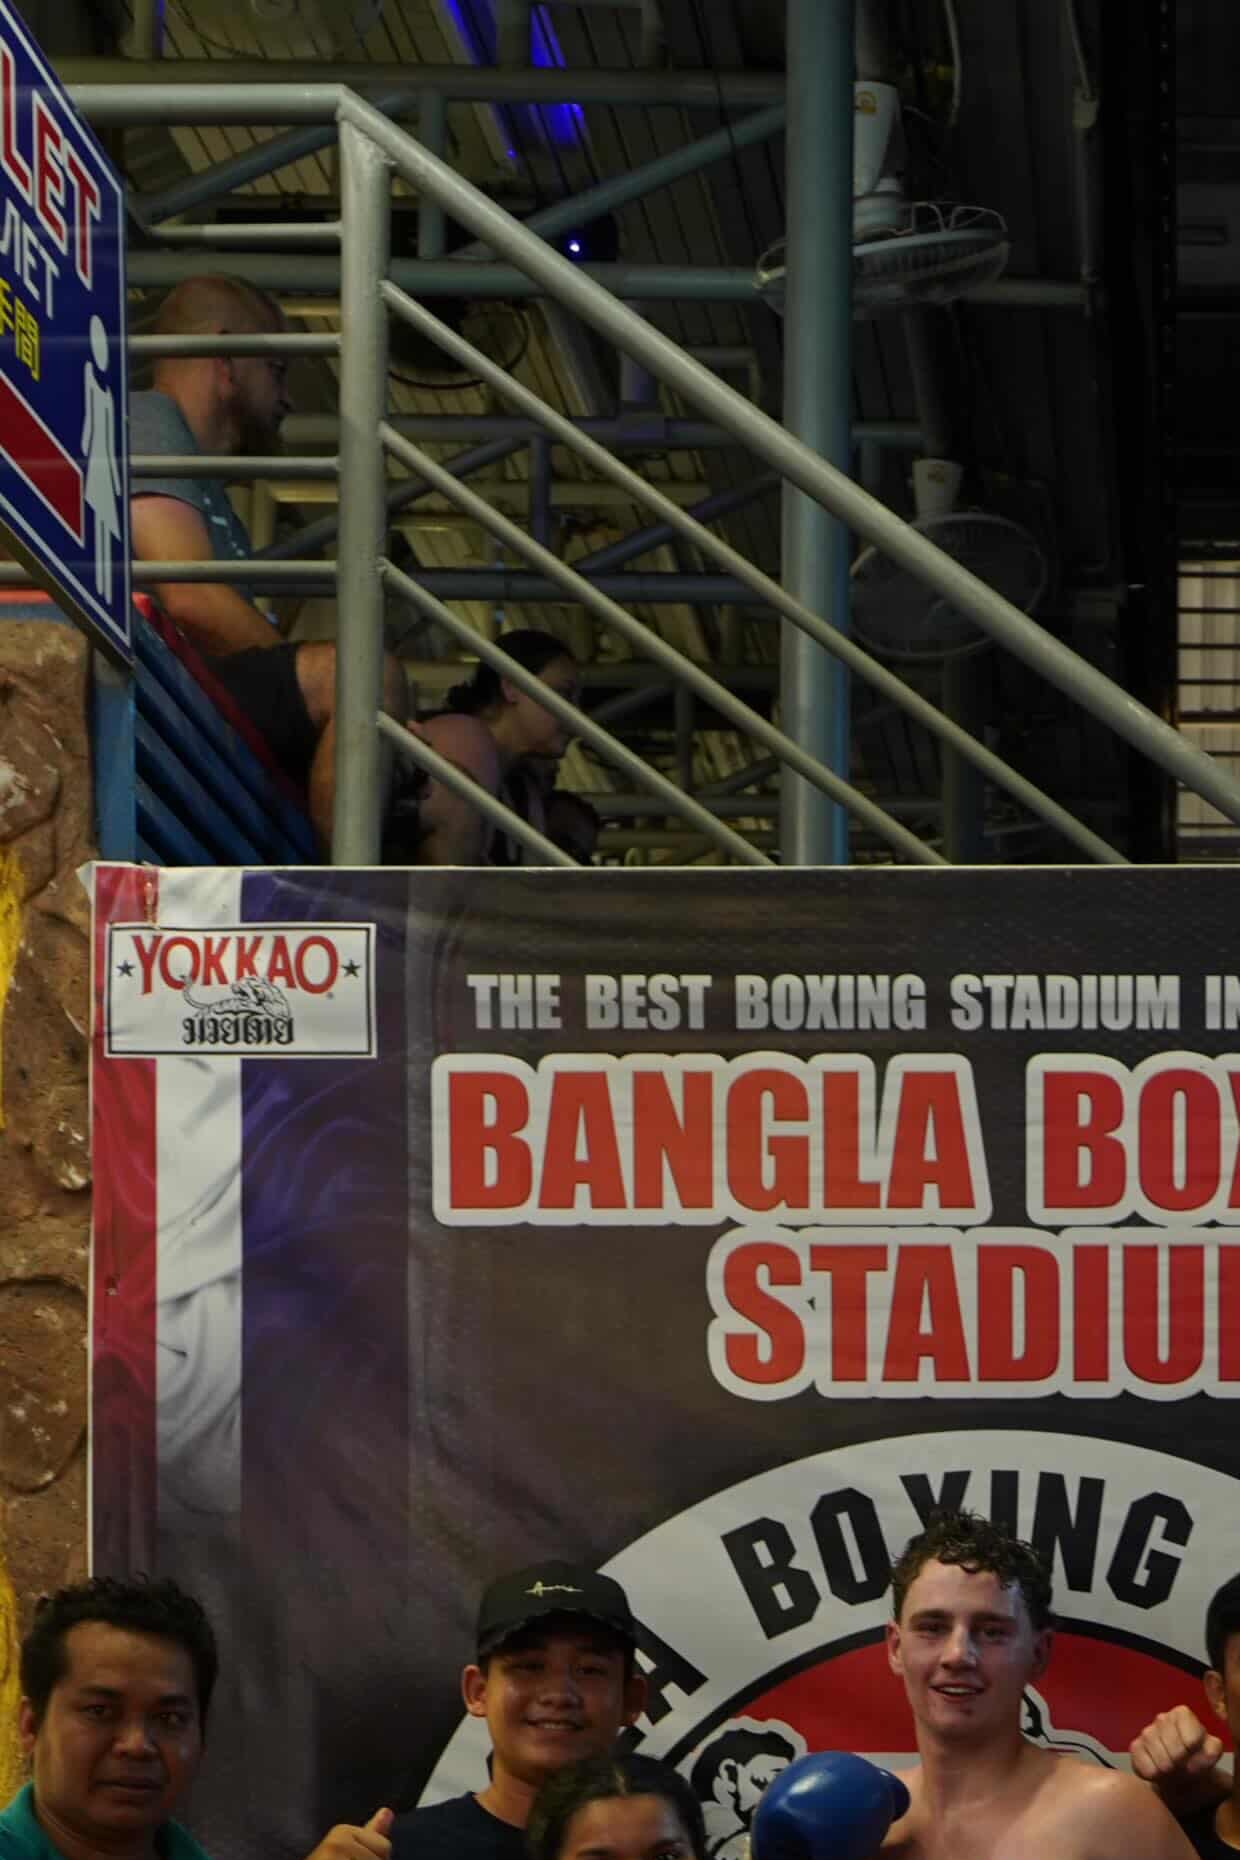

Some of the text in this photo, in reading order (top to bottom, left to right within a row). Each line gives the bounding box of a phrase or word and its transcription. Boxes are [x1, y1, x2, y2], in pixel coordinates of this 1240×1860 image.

[132, 935, 338, 995] YOKKAO
[466, 974, 562, 1031] THE
[586, 974, 712, 1031] BEST
[745, 974, 926, 1031] BOXING
[949, 974, 1181, 1031] STADIUM
[440, 1060, 984, 1217] BANGLA
